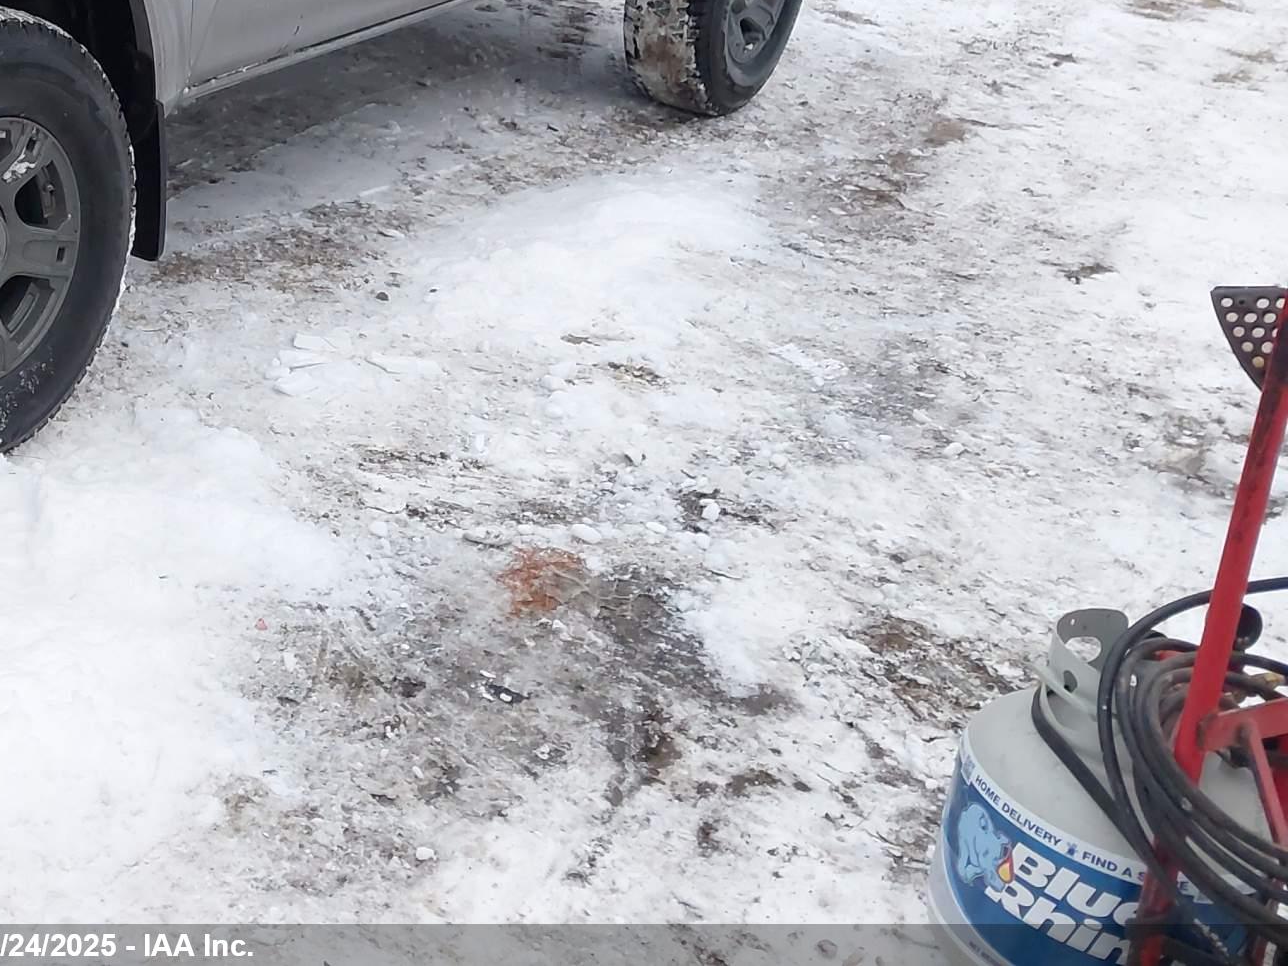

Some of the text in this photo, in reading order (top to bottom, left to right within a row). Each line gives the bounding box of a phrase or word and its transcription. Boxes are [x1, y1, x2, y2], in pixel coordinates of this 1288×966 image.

[974, 775, 1133, 879] HOME DELIVERY FIND A
[984, 881, 1133, 966] Rhin
